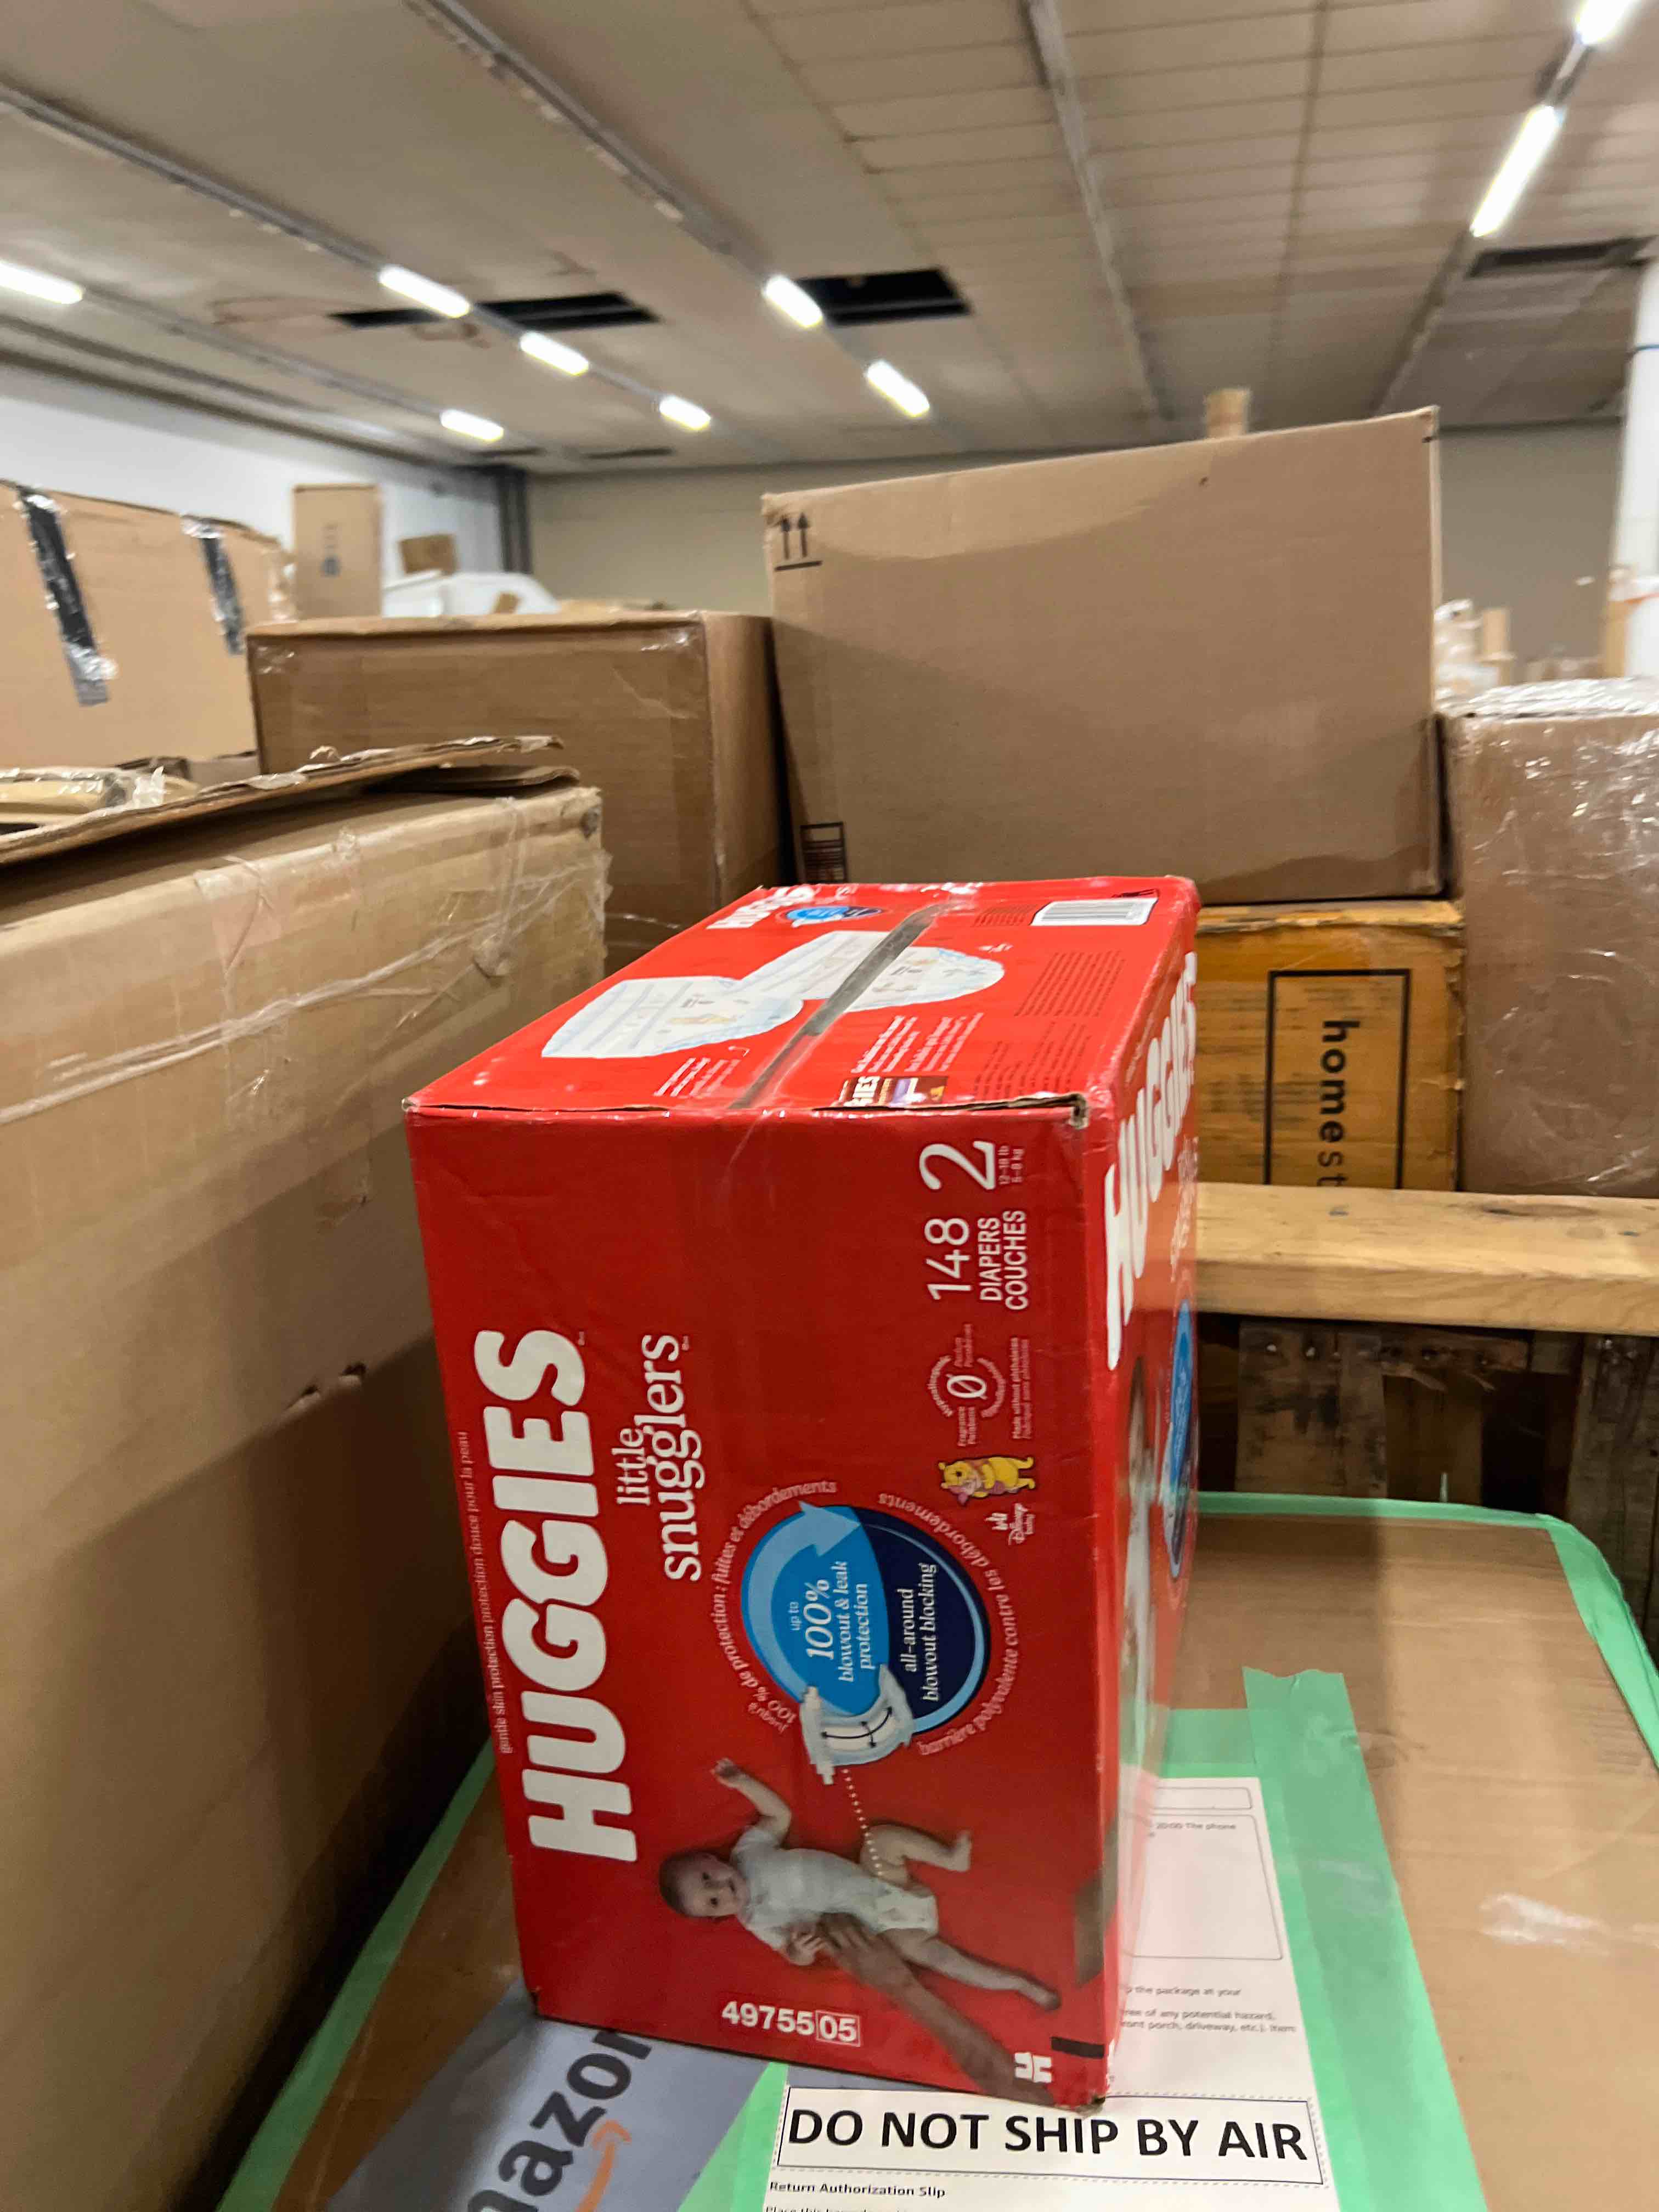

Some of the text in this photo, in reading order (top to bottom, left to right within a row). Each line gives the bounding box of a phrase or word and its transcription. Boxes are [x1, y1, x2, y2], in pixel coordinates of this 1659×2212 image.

[919, 1141, 995, 1190] 2
[1104, 952, 1197, 1370] HUGGIES
[924, 1218, 972, 1300] 148
[977, 1217, 1003, 1301] DIAPERS
[1003, 1210, 1028, 1310] COUCHES
[456, 1431, 476, 1464] peau
[459, 1467, 472, 1479] la
[611, 1427, 651, 1506] little
[634, 1335, 706, 1581] snugglers
[462, 1482, 479, 1512] pour
[878, 1492, 992, 1567] débordements
[466, 1516, 483, 1555] douce
[471, 1558, 495, 1623] protection
[474, 1330, 637, 1862] HUGGIES
[983, 1570, 1006, 1591] les
[788, 1601, 802, 1631] up to
[803, 1579, 836, 1660] 100%
[831, 1561, 854, 1682] blowout & leak
[854, 1583, 876, 1671] protection
[897, 1588, 917, 1673] all-around
[918, 1562, 939, 1701] blowout blocking
[995, 1594, 1019, 1646] contre
[482, 1626, 504, 1689] protection
[495, 1718, 514, 1754] gentle
[721, 2001, 856, 2042] 49755 05
[788, 2109, 1308, 2160] DO NOT SHIP BY AIR
[769, 2181, 946, 2199] Return Authorization Slip
